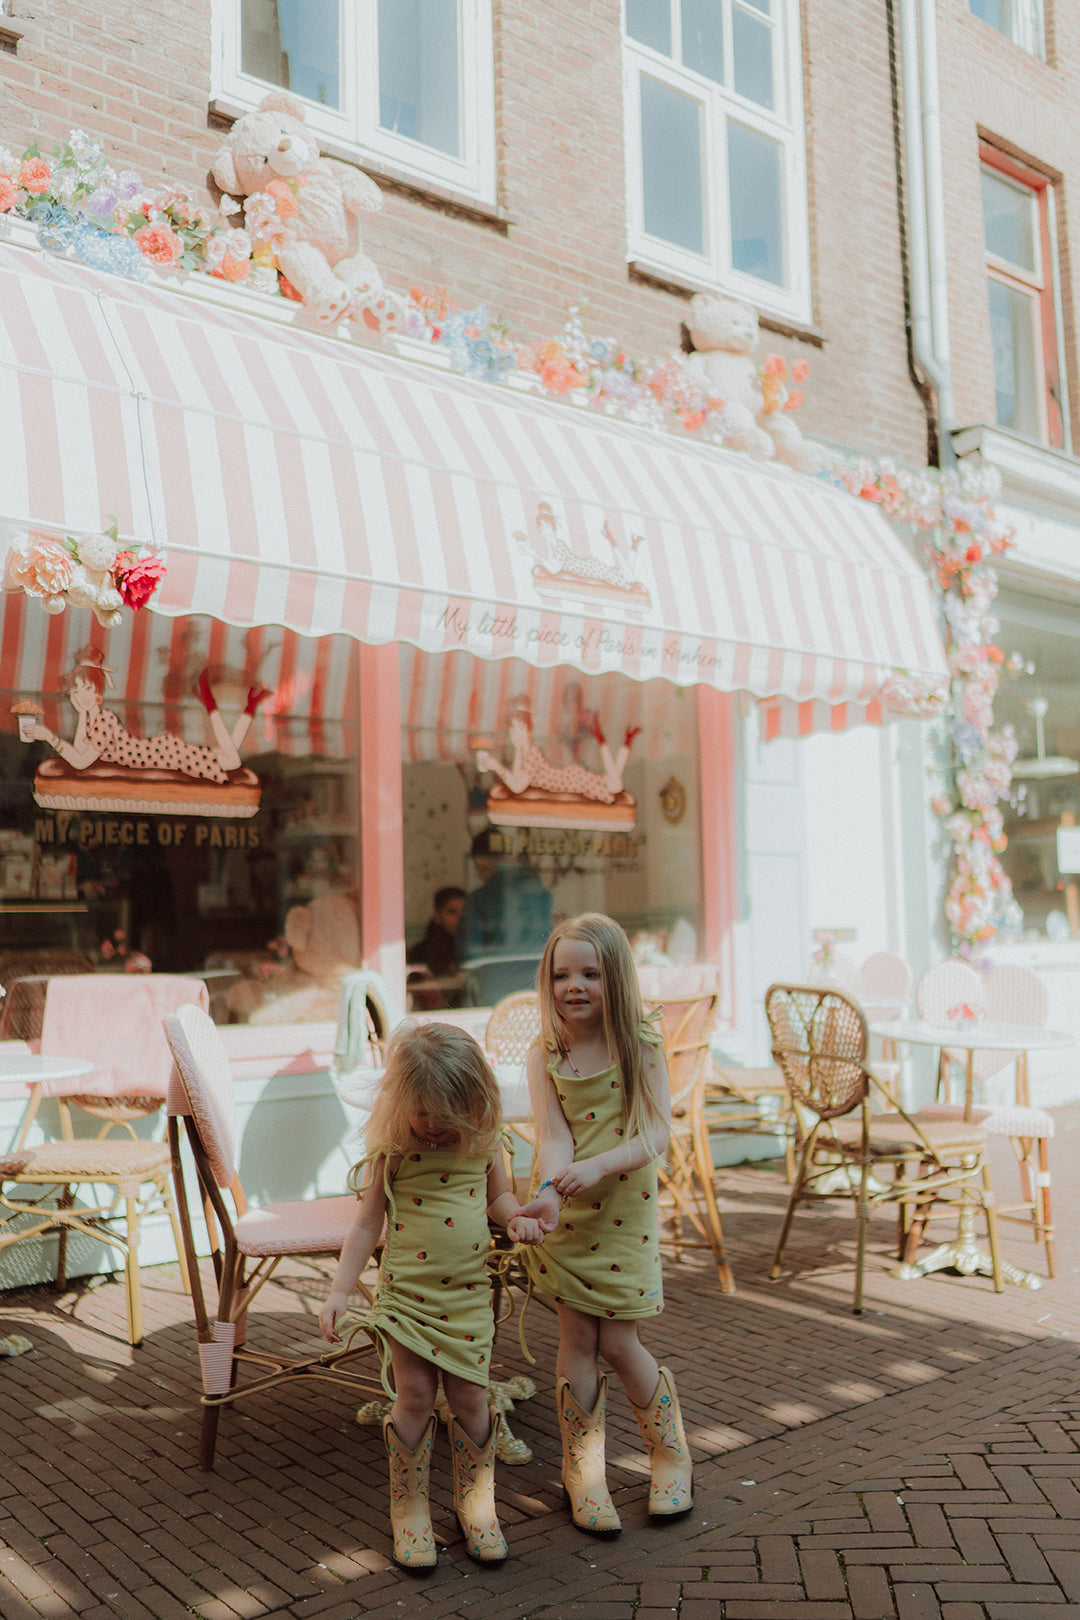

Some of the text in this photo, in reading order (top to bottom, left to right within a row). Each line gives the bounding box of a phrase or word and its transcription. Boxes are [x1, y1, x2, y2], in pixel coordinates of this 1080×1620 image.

[476, 610, 522, 640] little
[573, 627, 596, 660] of
[34, 818, 261, 848] MY PIECE OF PARIS
